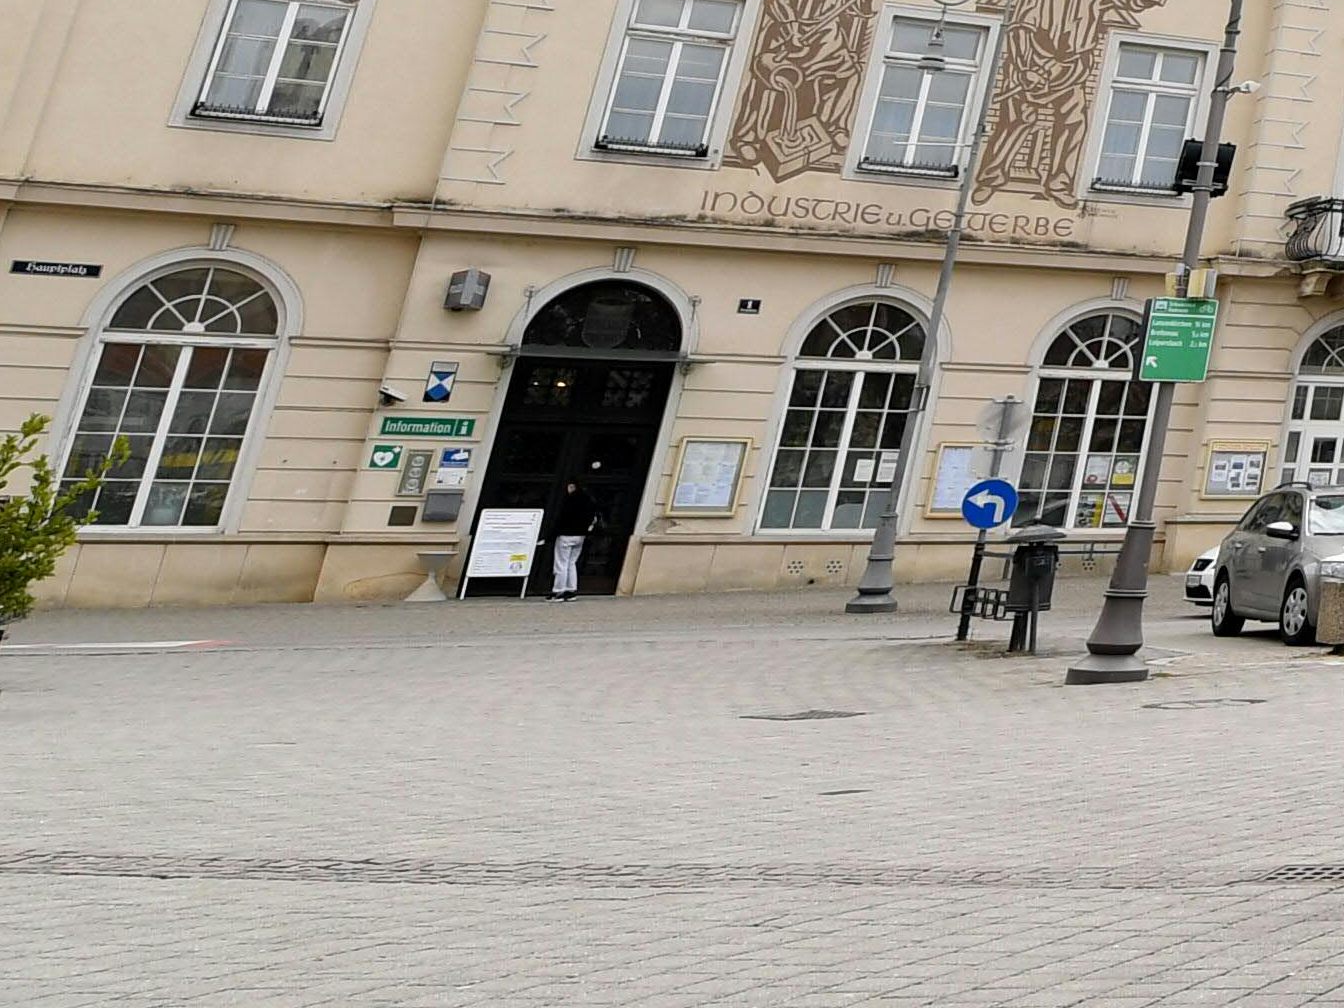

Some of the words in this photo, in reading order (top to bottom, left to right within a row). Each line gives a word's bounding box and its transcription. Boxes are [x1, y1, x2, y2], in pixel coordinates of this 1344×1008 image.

[700, 190, 883, 225] INDUSTRIE
[909, 208, 1075, 237] GEWERBE
[25, 261, 88, 275] Hauptplatz
[384, 419, 452, 435] Information
